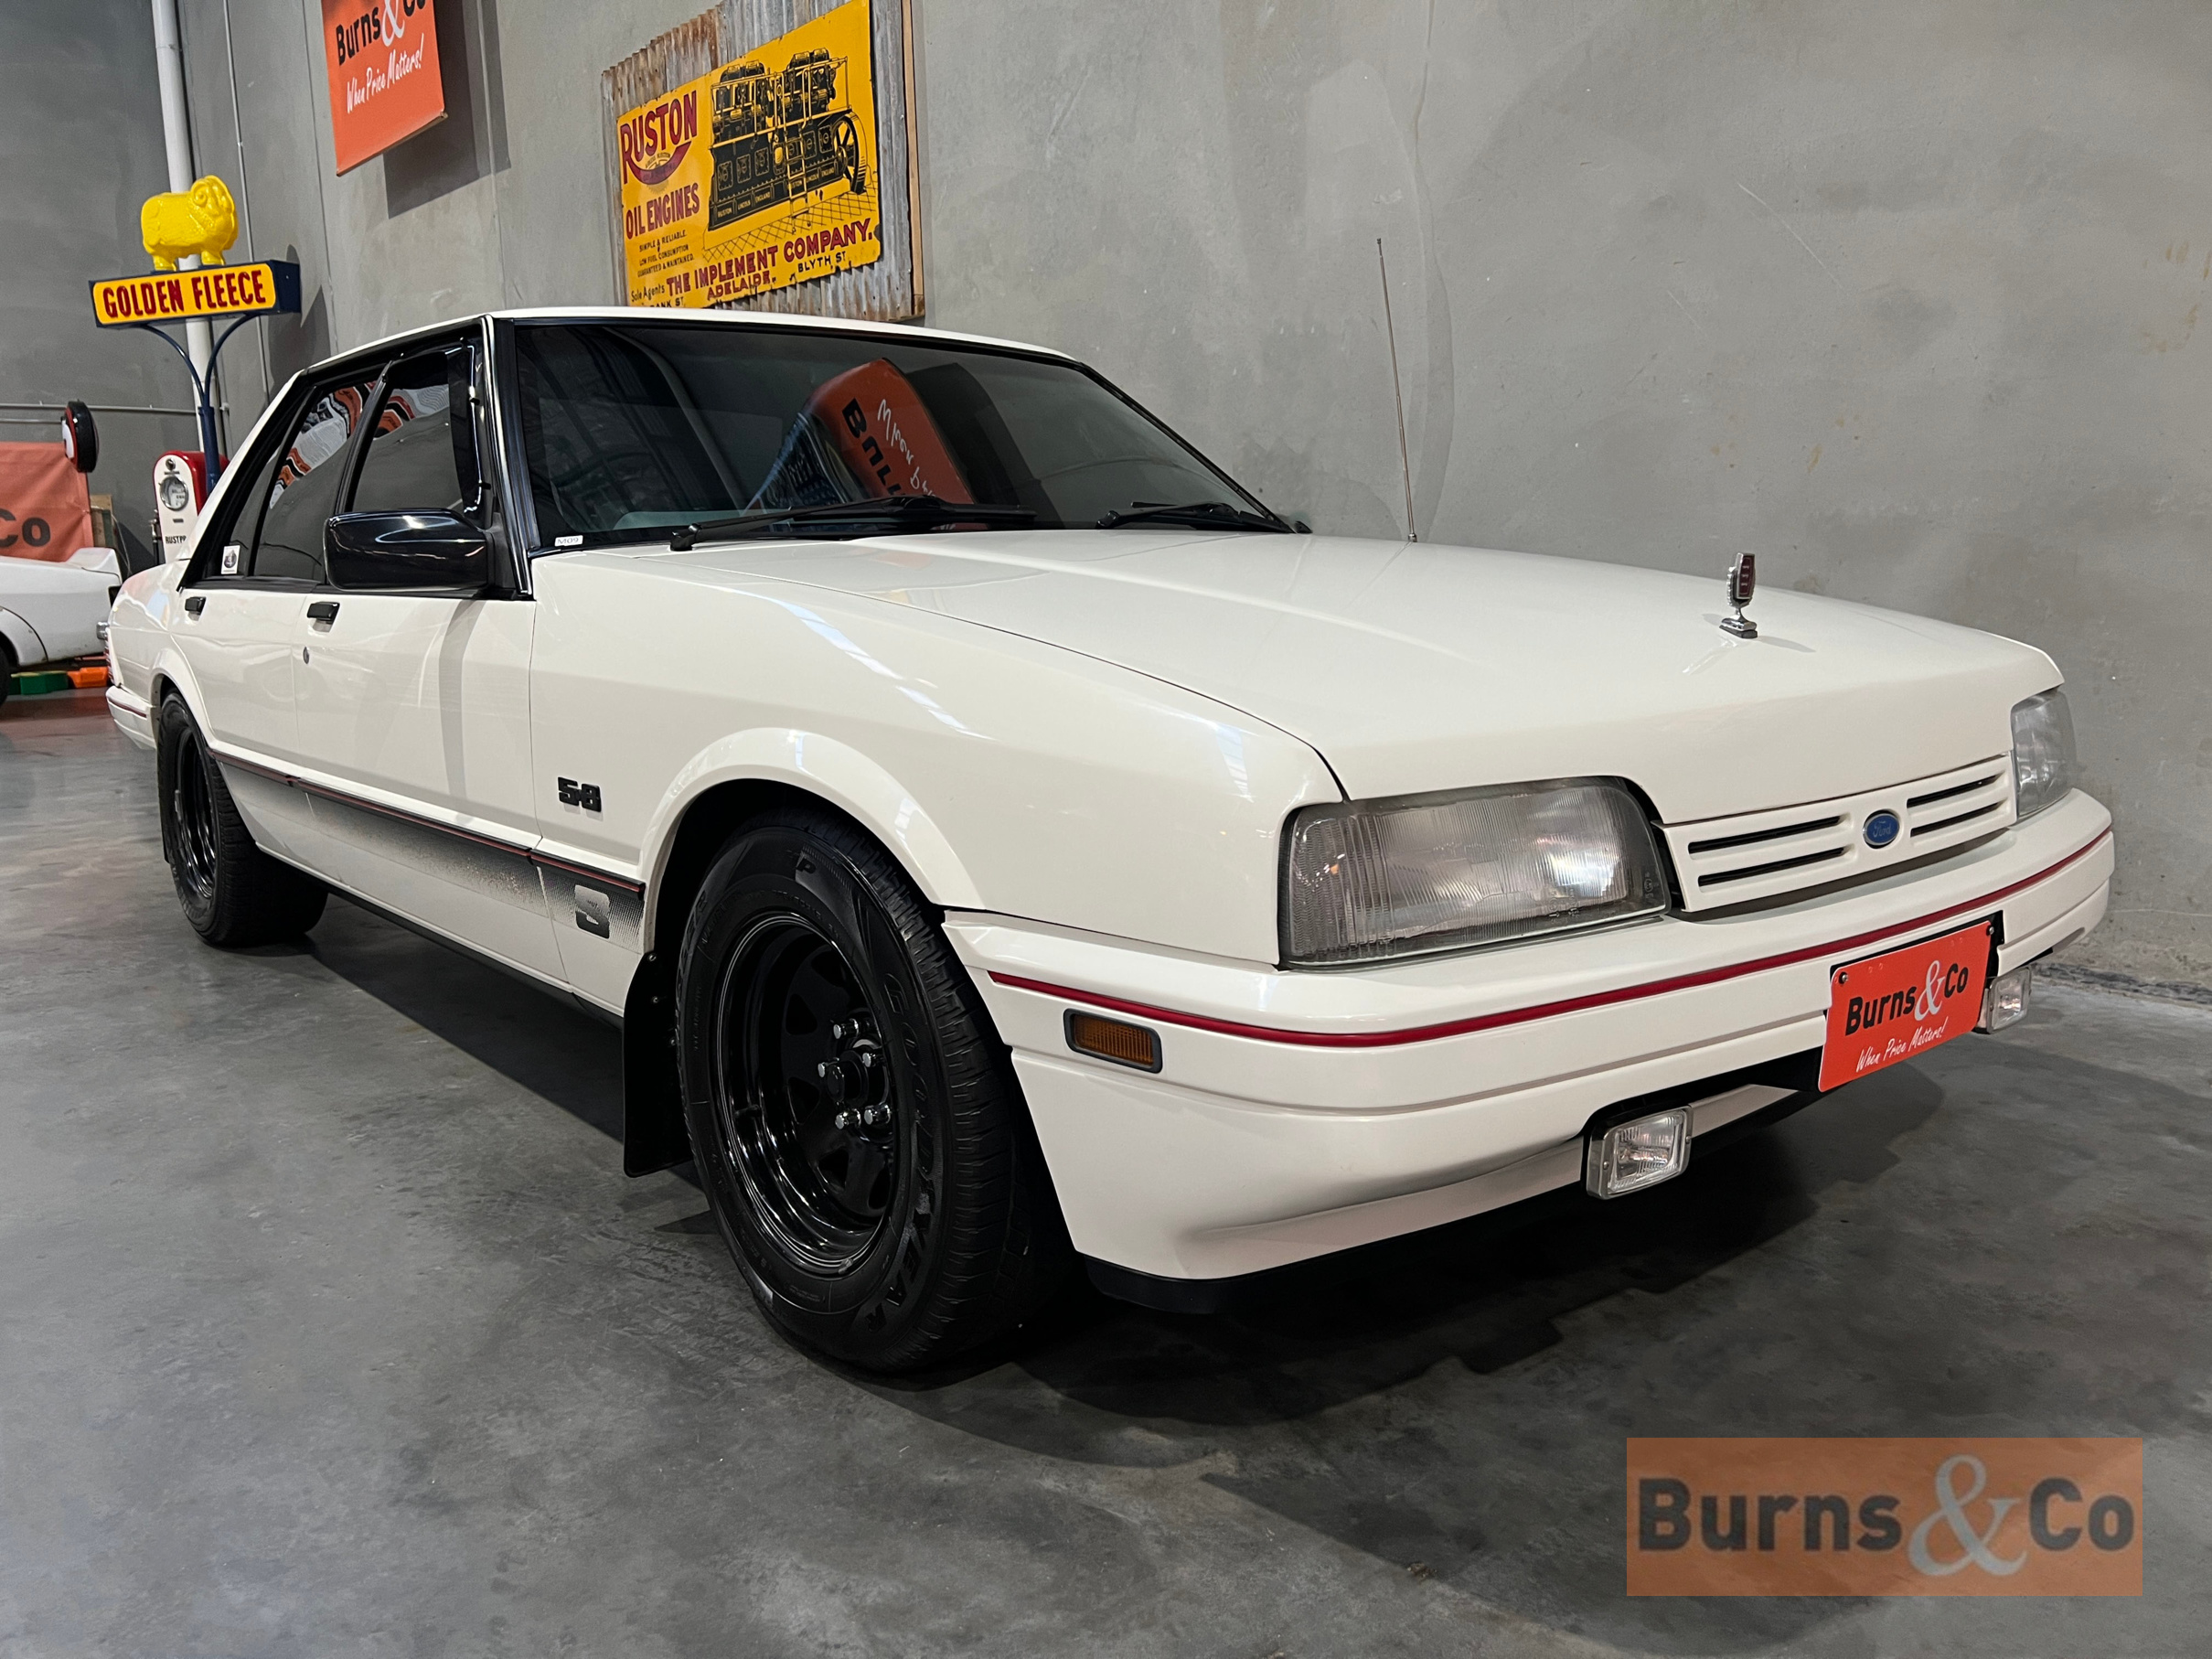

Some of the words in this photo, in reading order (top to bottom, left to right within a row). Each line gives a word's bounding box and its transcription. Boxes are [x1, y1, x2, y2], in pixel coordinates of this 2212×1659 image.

[347, 77, 366, 114] When
[366, 67, 386, 101] Price
[387, 33, 424, 89] Matters!
[620, 90, 698, 185] RUSTON
[625, 205, 646, 240] OIL
[647, 183, 700, 231] ENGINES
[631, 290, 642, 303] Sole
[643, 283, 666, 301] Agents
[666, 273, 691, 297] THE
[695, 245, 778, 290] IMPLEMENT
[784, 218, 873, 262] COMPANY.
[637, 263, 661, 278] GUARANTEED
[639, 240, 656, 252] SIMPLE
[647, 254, 657, 263] FUEL
[658, 243, 689, 260] CONSUMPTION
[797, 256, 831, 273] BLYTH
[836, 251, 847, 263] ST
[102, 278, 185, 318] GOLDEN
[191, 270, 266, 310] FLEECE
[675, 296, 684, 307] ST
[1872, 820, 1892, 838] Ford
[1845, 960, 1969, 1036] Burns&Co
[1856, 1047, 1879, 1073] When
[1883, 1038, 1907, 1062] Price
[1908, 1016, 1949, 1052] Matters!
[864, 971, 935, 1333] GOODYEAR
